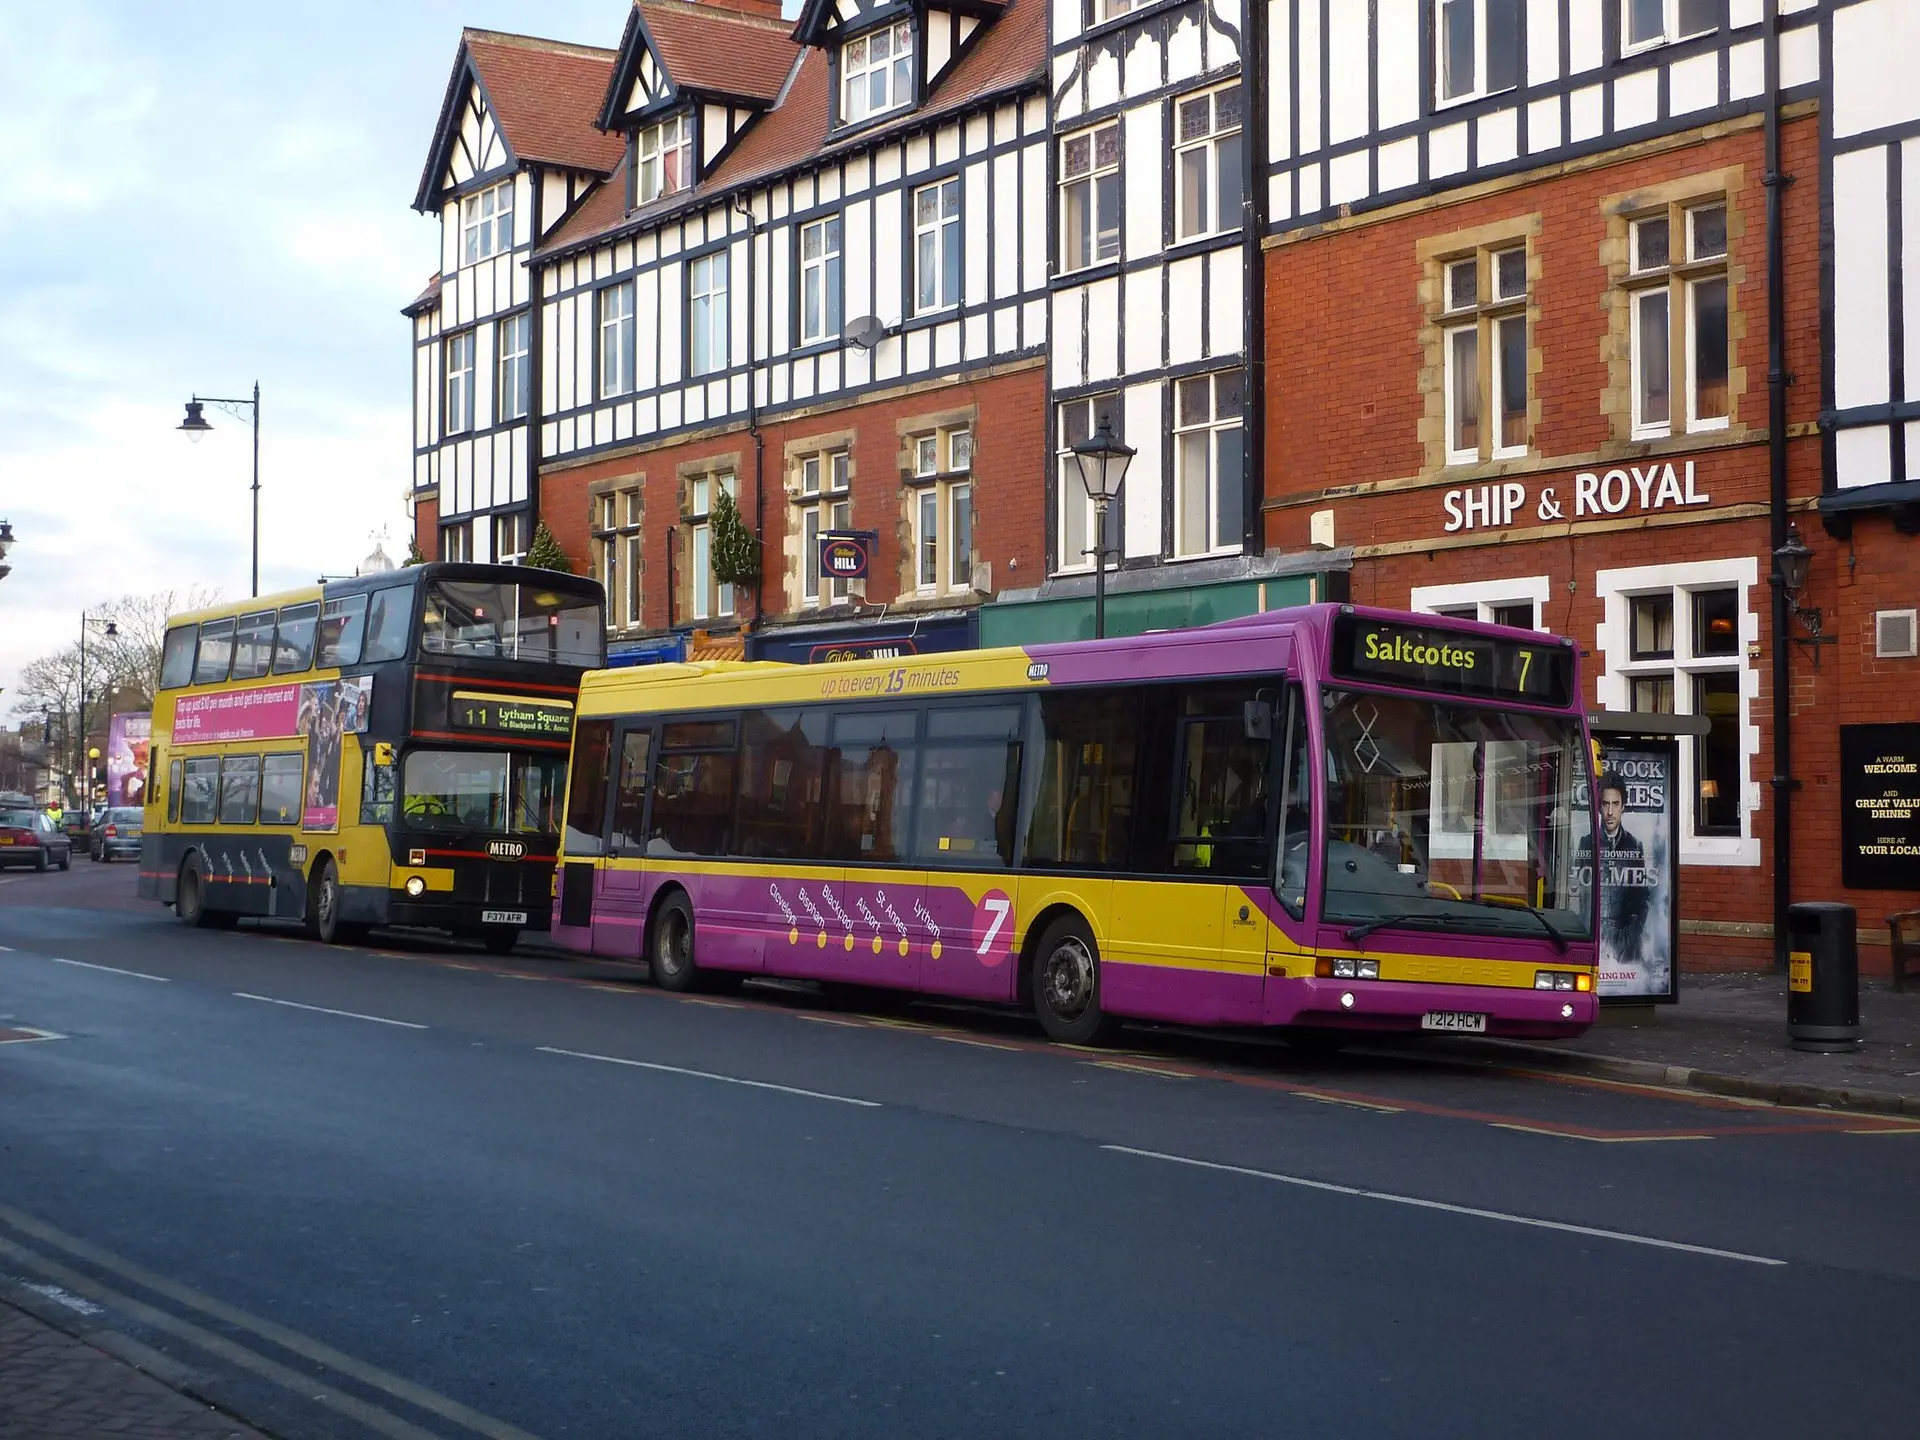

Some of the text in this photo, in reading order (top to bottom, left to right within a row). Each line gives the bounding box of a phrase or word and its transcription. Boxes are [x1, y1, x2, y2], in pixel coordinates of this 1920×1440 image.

[1443, 460, 1710, 532] SHIP & ROYAL
[834, 557, 857, 569] HILL
[1028, 664, 1049, 677] METRO
[1365, 633, 1532, 692] Saltcotes 7
[821, 668, 960, 698] up to every 15 minutes
[466, 708, 570, 725] 11 Lytham Square
[499, 720, 508, 728] via
[509, 721, 536, 732] Blackpool
[1864, 764, 1918, 774] WELCOME
[1855, 799, 1920, 808] GREAT VALU
[1871, 809, 1912, 819] DRINKS
[489, 842, 523, 857] METRO
[1604, 850, 1641, 859] DOWNEY
[1859, 845, 1920, 855] YOUR LOCA
[769, 883, 798, 926] Cleveleys
[798, 887, 825, 928] Bispham
[822, 884, 854, 931] Blackpool
[507, 912, 522, 923] AFR
[856, 897, 882, 934] Airport
[876, 890, 908, 937] St Annes
[914, 898, 941, 938] Lytham
[977, 898, 1010, 954] 7
[1619, 972, 1637, 980] DAY
[1428, 1013, 1481, 1029] T212 HCW
